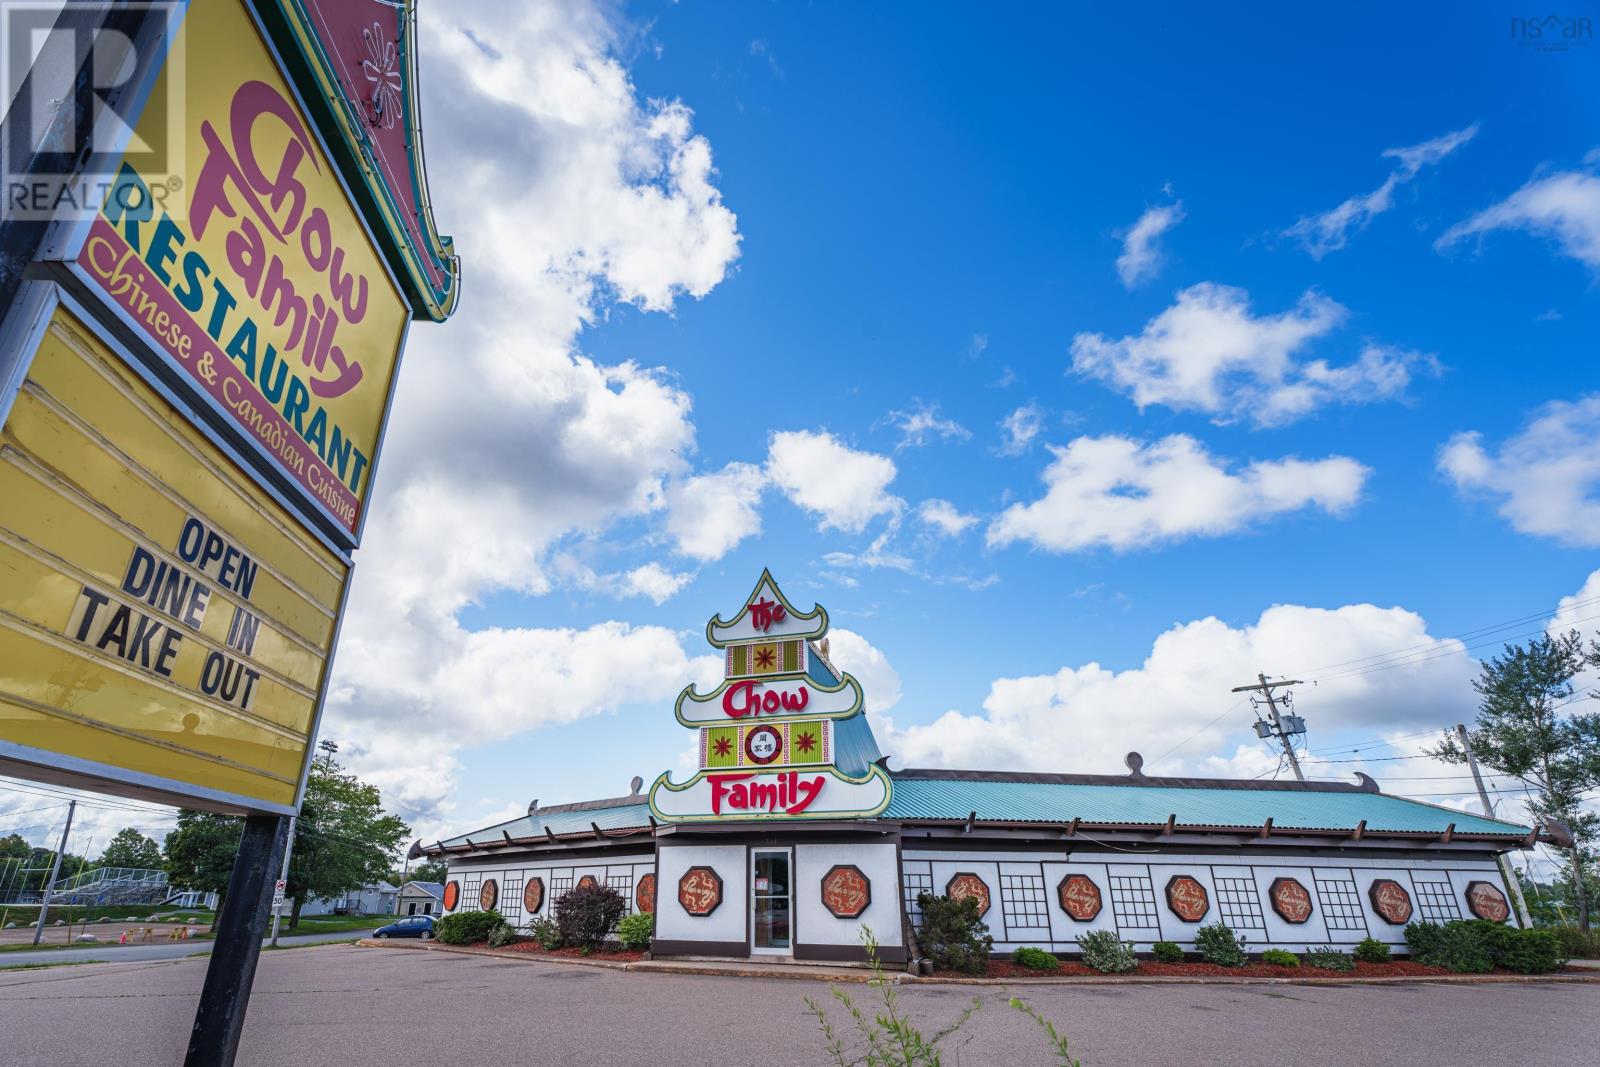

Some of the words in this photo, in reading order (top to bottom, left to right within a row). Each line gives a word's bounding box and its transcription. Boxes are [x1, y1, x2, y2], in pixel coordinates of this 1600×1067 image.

[189, 120, 363, 398] Family
[230, 80, 368, 324] Chow
[87, 236, 192, 358] Chinese
[197, 351, 217, 386] &
[222, 376, 303, 476] Canadian
[307, 463, 355, 525] Cuisine
[102, 161, 367, 493] RESTAURANT
[122, 546, 211, 630] DINE
[228, 606, 260, 656] IN
[178, 517, 258, 600] OPEN
[76, 586, 183, 678] TAKE
[200, 651, 260, 709] OUT
[722, 680, 809, 718] Chow
[707, 771, 826, 815] Family
[274, 897, 282, 905] 50
